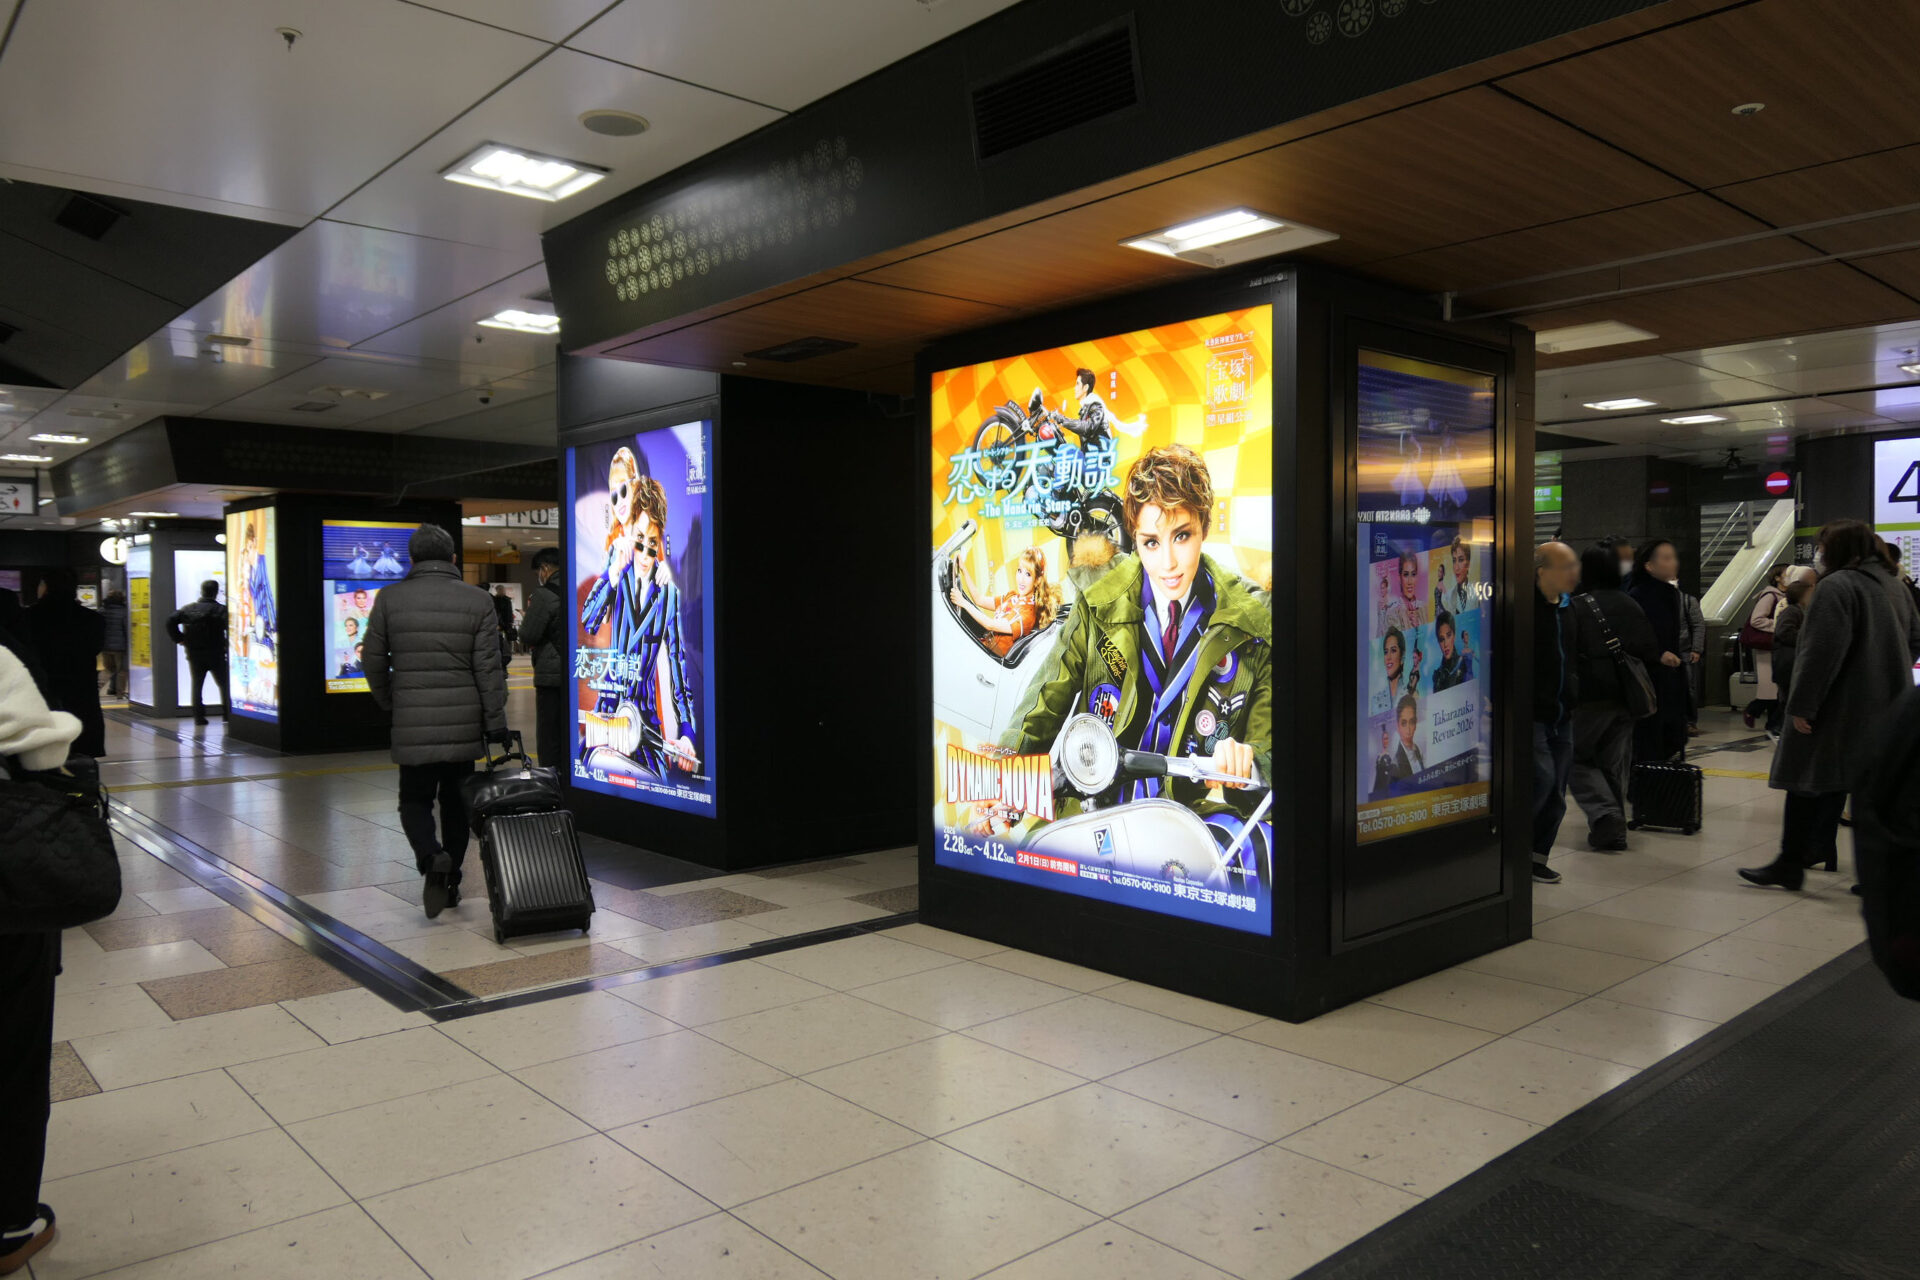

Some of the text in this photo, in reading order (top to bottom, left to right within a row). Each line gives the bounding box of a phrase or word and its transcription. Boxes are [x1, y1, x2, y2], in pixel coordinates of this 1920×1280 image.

[943, 437, 1121, 505] 恋する天動説
[1888, 460, 1920, 514] 4
[573, 645, 642, 687] 恋する天動説
[1433, 700, 1474, 726] Takarazuka
[1433, 718, 1474, 744] Revue 2026
[947, 744, 1055, 822] DYNAMIC NOVA
[1431, 793, 1488, 818] 東京宝塚劇場
[1173, 883, 1257, 913] 東京宝塚劇場
